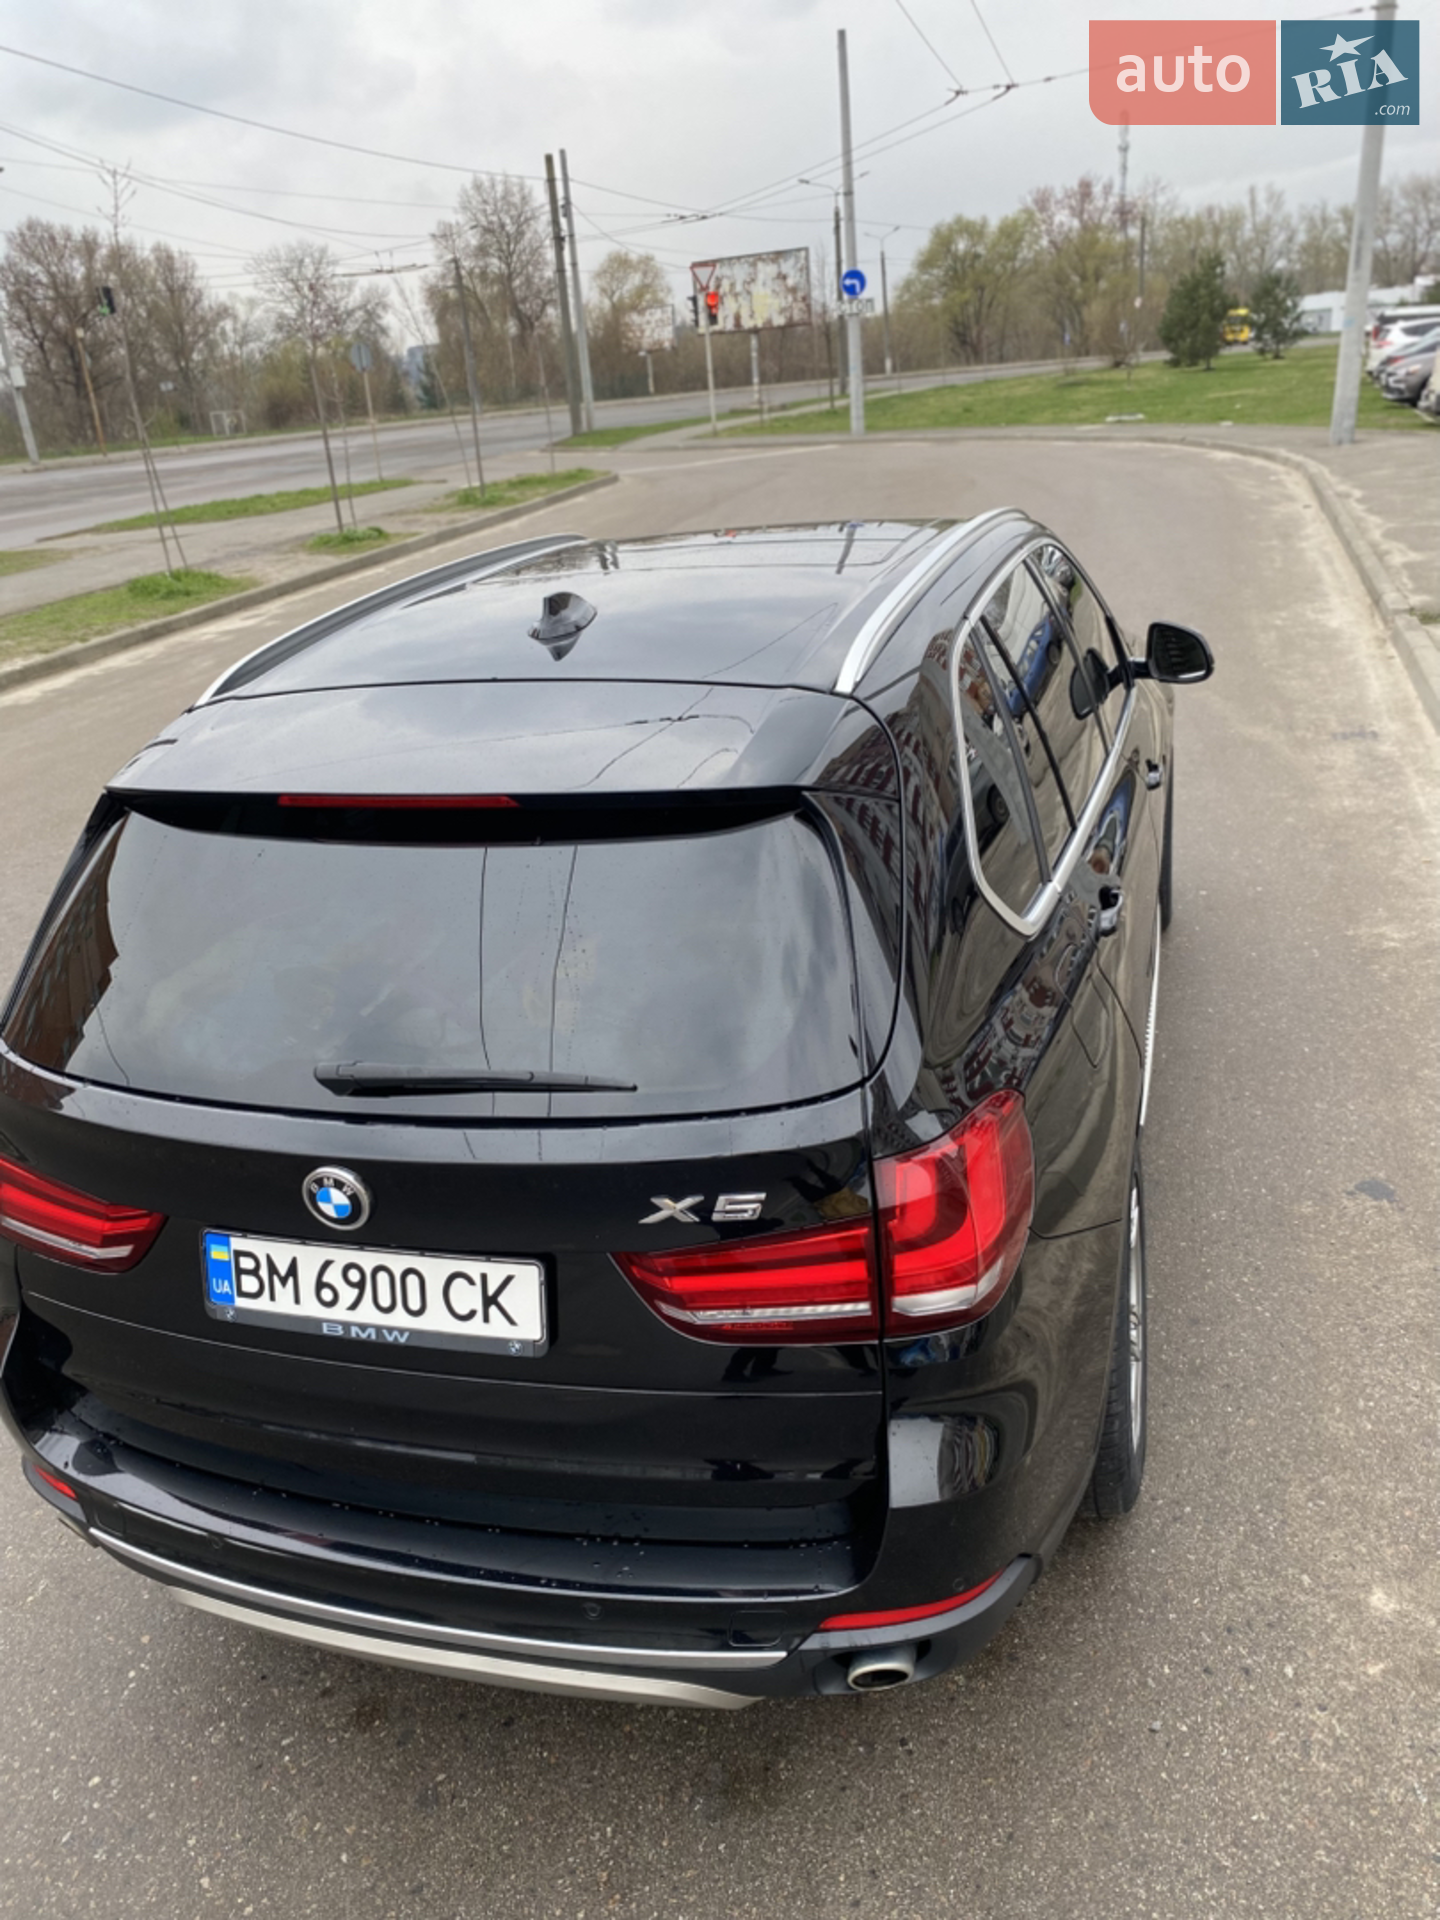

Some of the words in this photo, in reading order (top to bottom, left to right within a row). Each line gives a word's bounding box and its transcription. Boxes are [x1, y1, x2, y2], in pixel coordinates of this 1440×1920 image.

[310, 1177, 356, 1196] BMW
[638, 1191, 767, 1224] X5
[212, 1278, 232, 1296] UA
[232, 1249, 301, 1306] BM
[314, 1259, 428, 1318] 6900
[442, 1270, 518, 1327] CK
[321, 1321, 410, 1344] BMW
